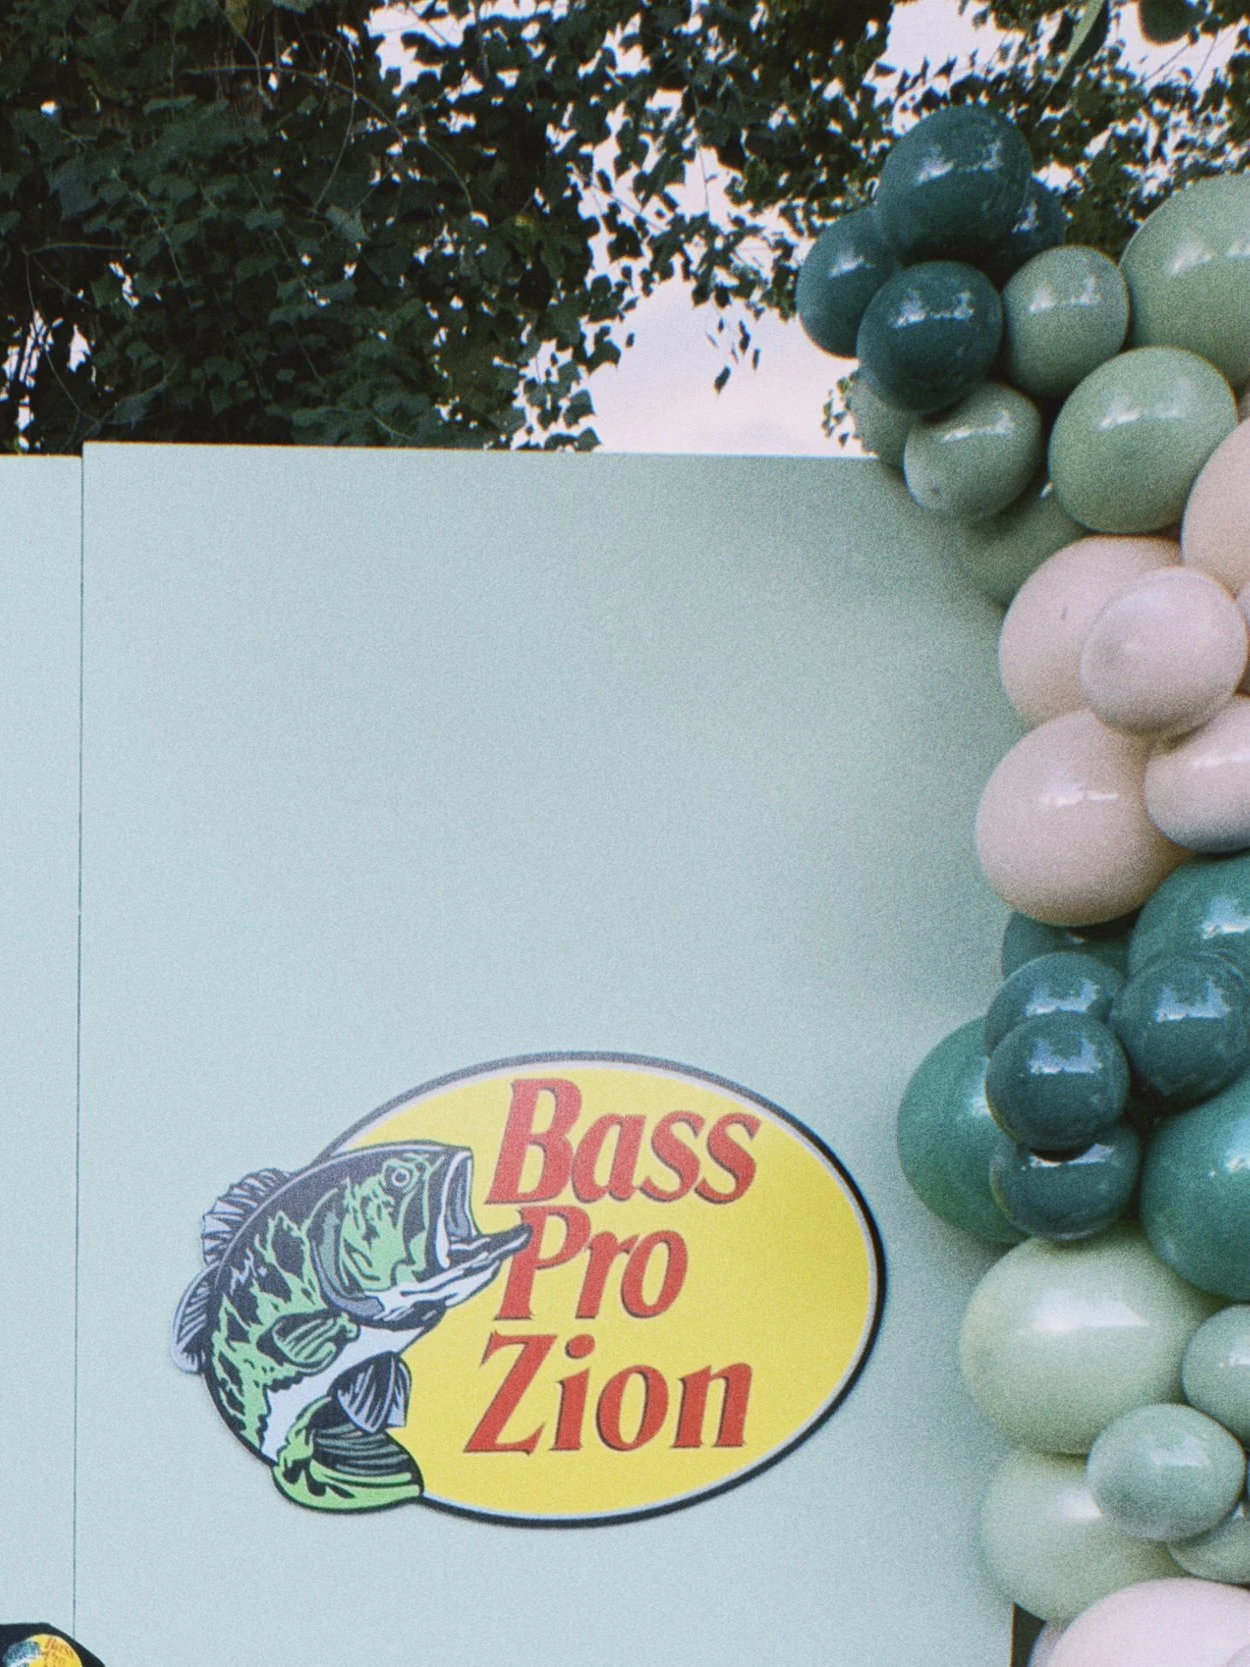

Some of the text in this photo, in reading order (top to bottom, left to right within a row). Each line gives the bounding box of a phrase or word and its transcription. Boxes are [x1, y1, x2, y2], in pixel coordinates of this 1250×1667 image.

[484, 1077, 761, 1207] Bass
[494, 1206, 688, 1321] Pro
[463, 1331, 753, 1456] Zion
